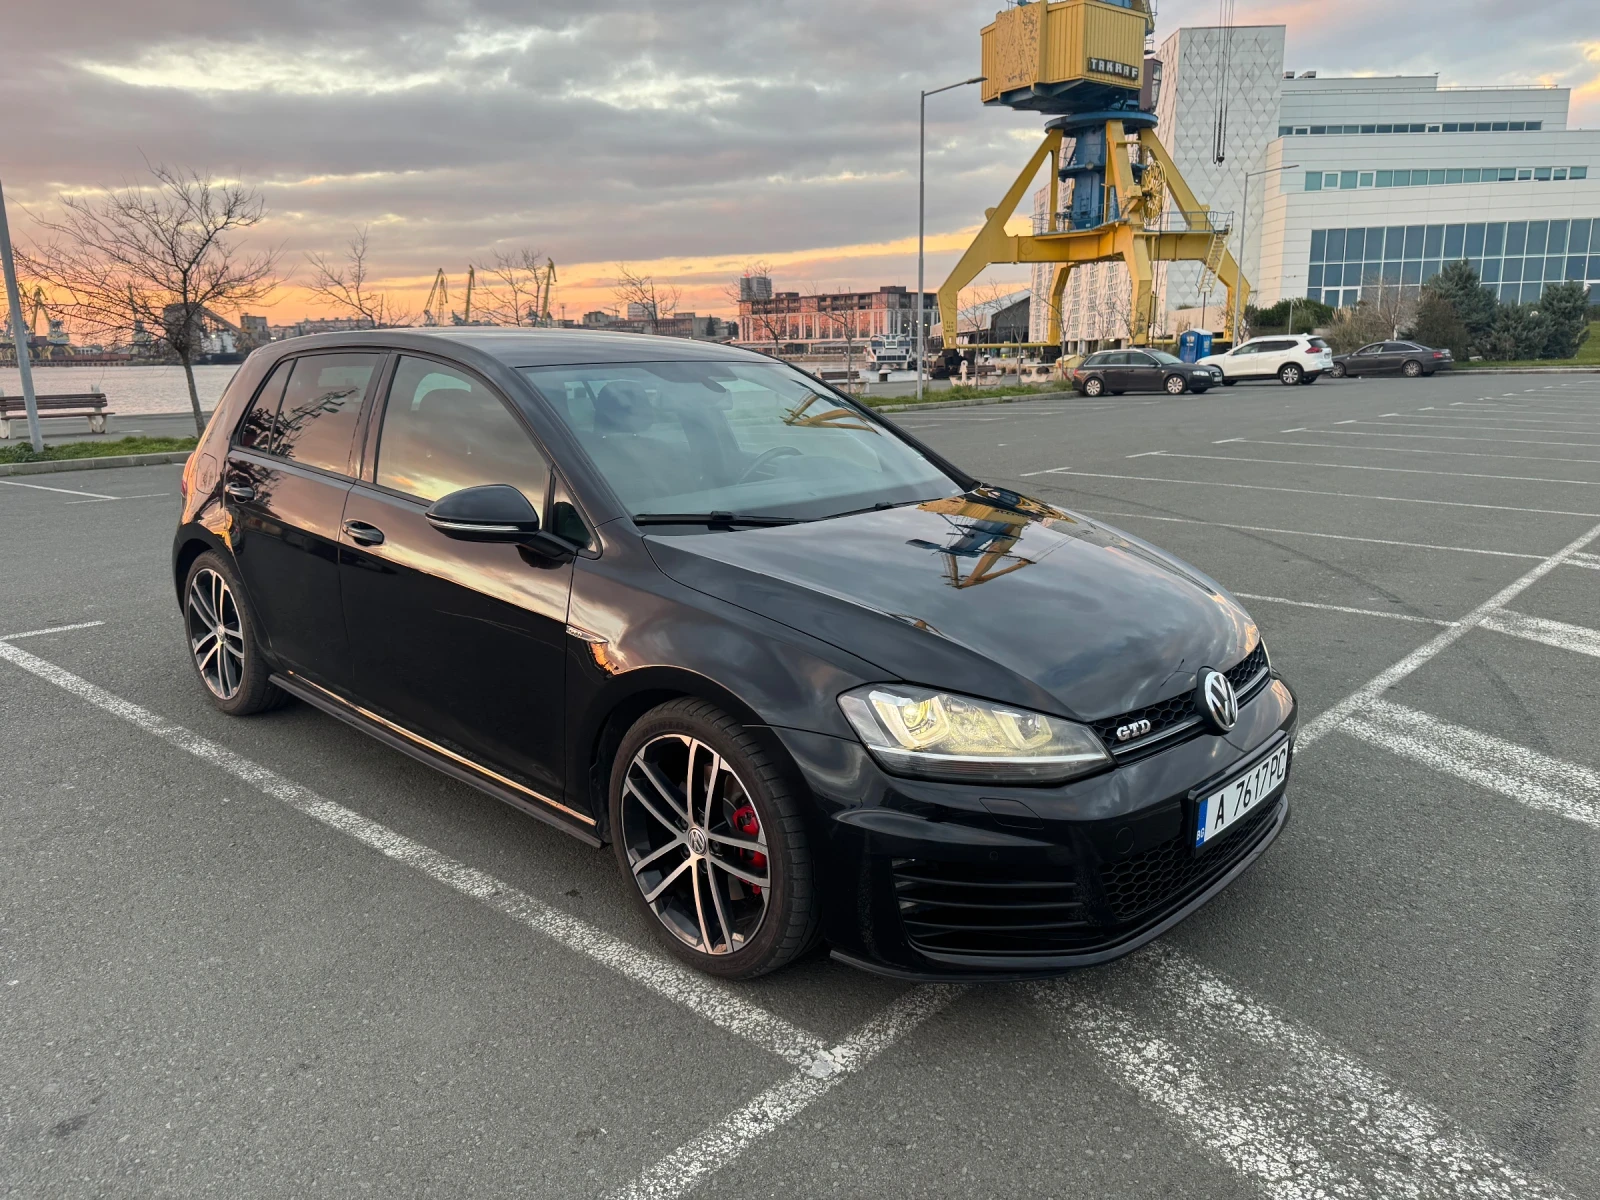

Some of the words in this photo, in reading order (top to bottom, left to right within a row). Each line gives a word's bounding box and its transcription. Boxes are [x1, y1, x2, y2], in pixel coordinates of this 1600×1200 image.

[1091, 58, 1138, 78] TAKRAF
[642, 720, 695, 737] DUNLOP
[1116, 719, 1151, 741] GTD
[1214, 793, 1225, 830] A
[1196, 827, 1205, 841] BG
